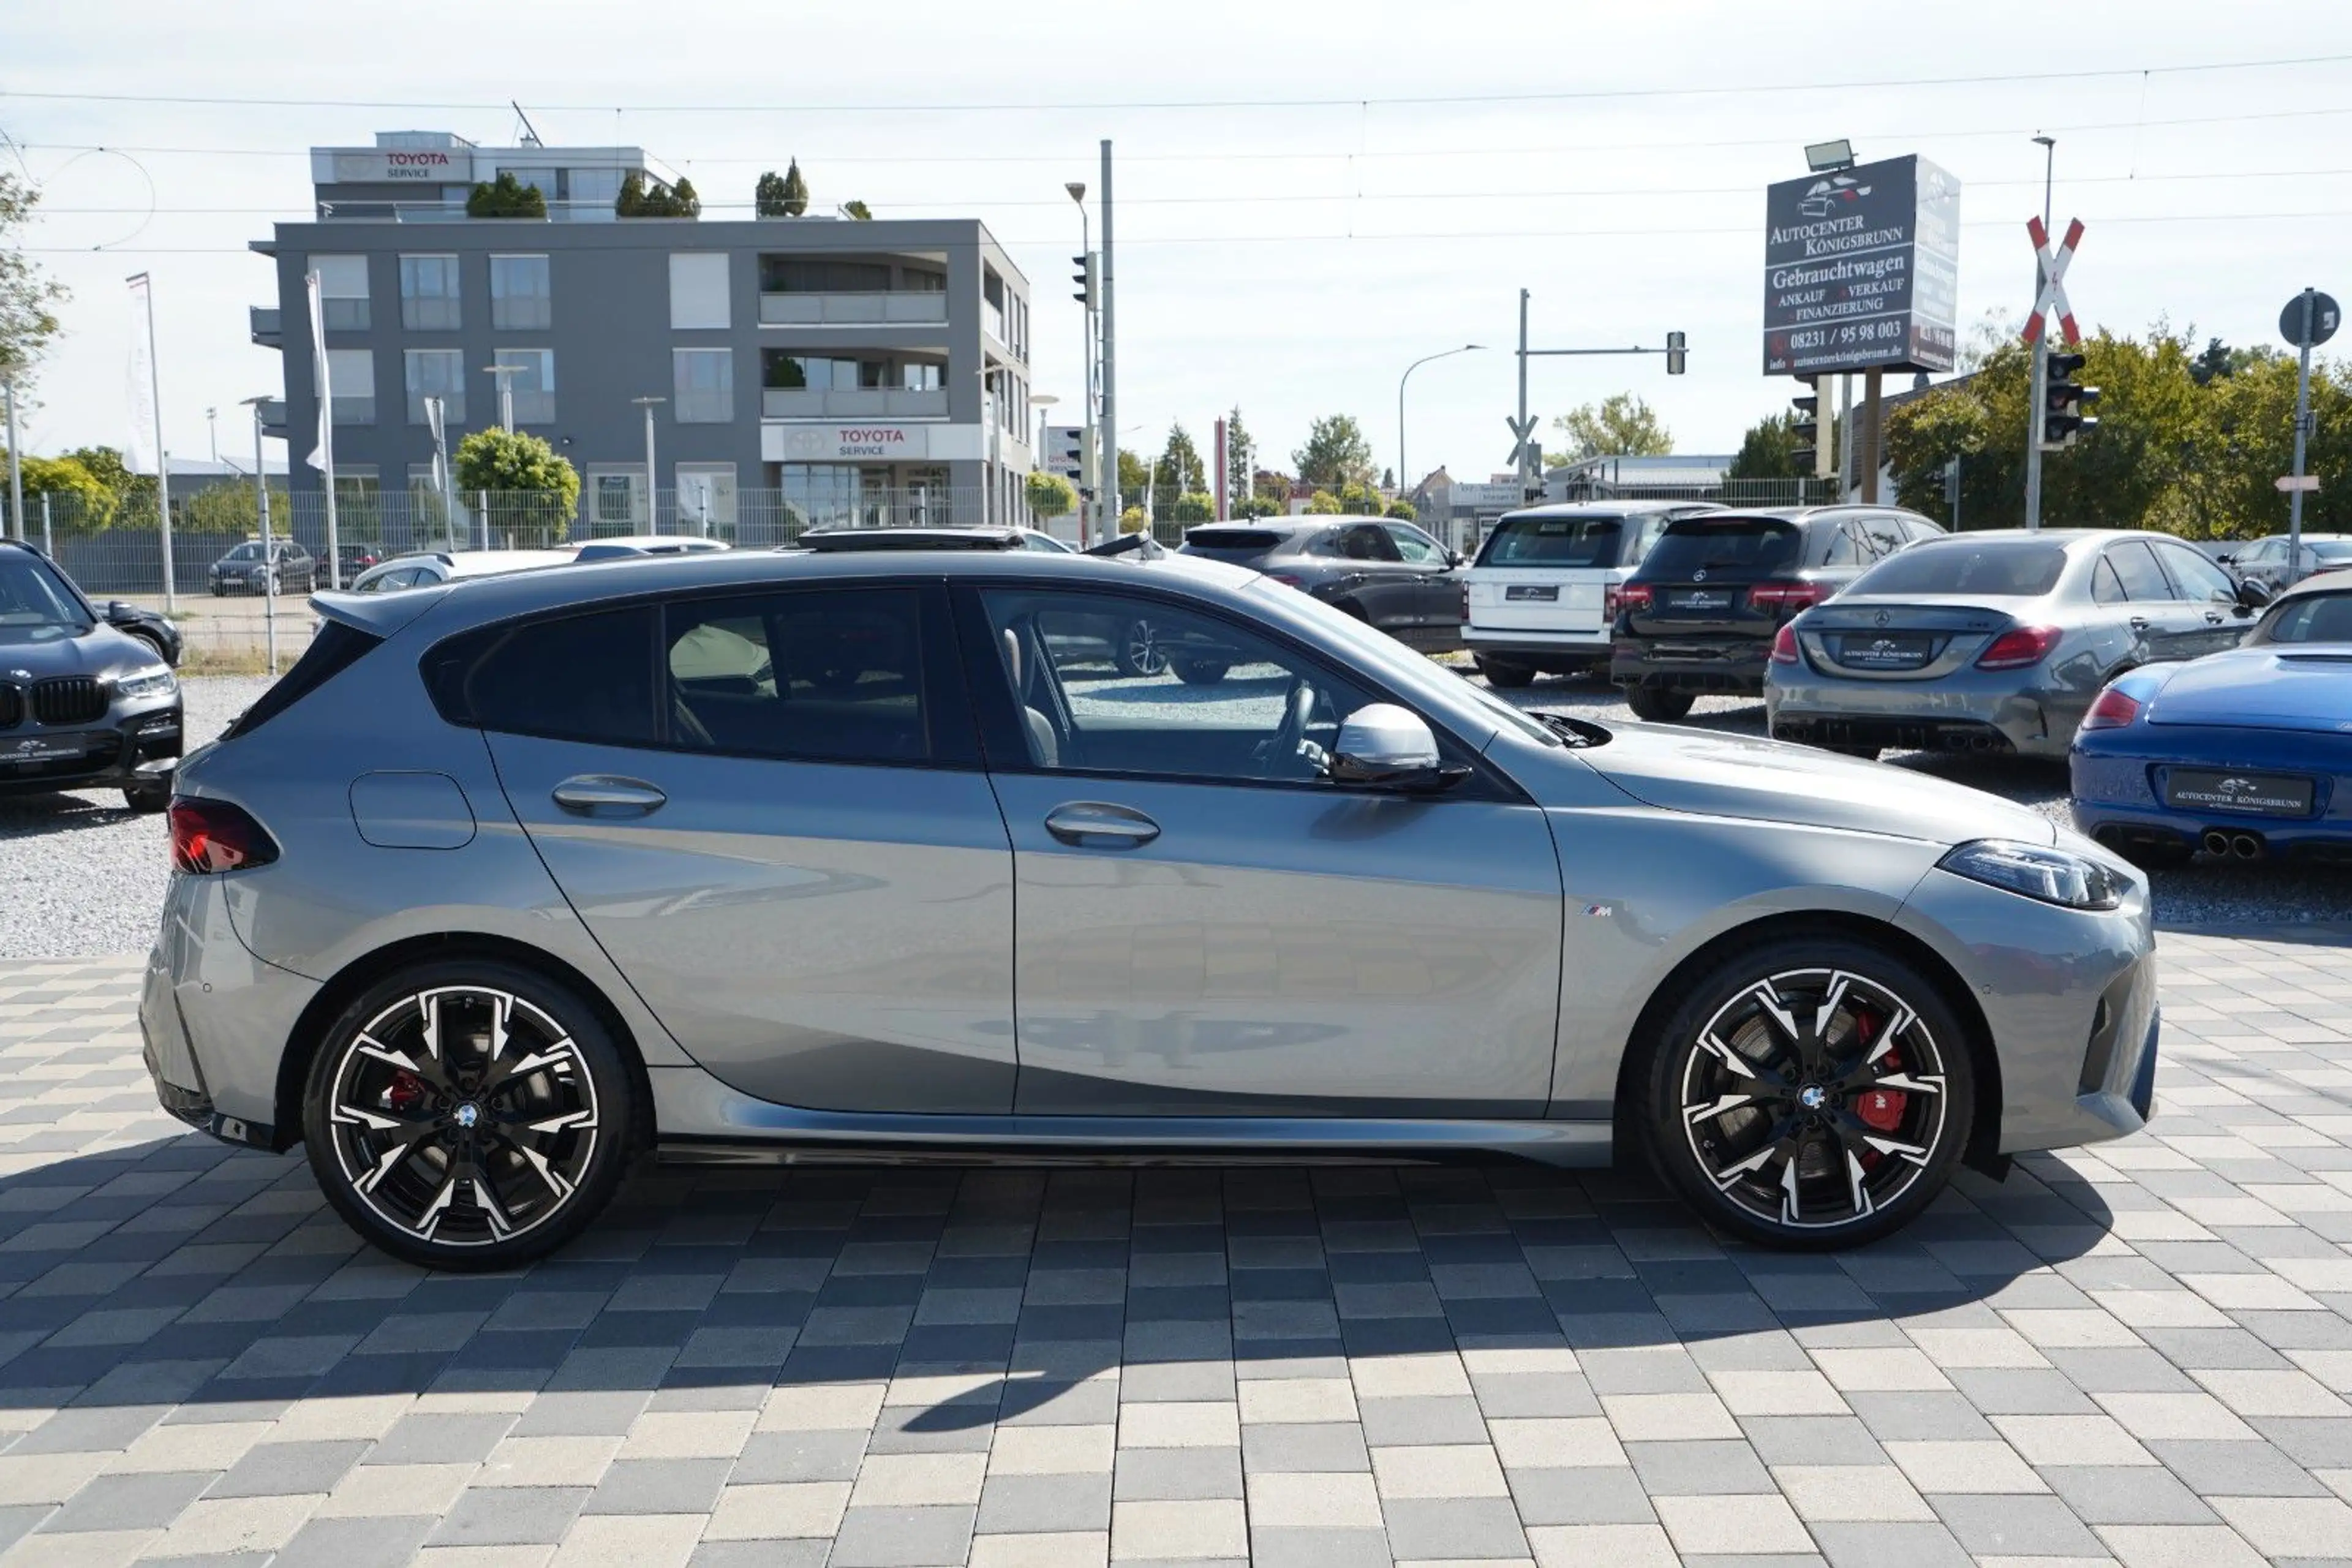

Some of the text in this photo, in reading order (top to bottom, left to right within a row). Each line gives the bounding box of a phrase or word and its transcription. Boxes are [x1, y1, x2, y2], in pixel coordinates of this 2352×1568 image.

[386, 153, 449, 165] TOYOTA
[387, 168, 429, 178] SERVICE
[1770, 214, 1864, 246] AUTOCENTER
[1805, 225, 1903, 256] KÖNIGSBRUNN
[1773, 255, 1904, 289] Gebrauchtwagen
[1778, 278, 1905, 307] ANKAUF VERKAUF
[1795, 297, 1884, 322] FINANZIERUNG
[1790, 330, 1825, 349] 08231
[1841, 326, 1856, 343] 95
[1859, 324, 1874, 341] 98
[1878, 320, 1901, 338] 003
[840, 429, 904, 442] TOYOTA
[839, 445, 885, 456] SERVICE
[2176, 791, 2233, 803] AUTOCENTER
[2236, 796, 2302, 808] KÖNIGSBRUNN
